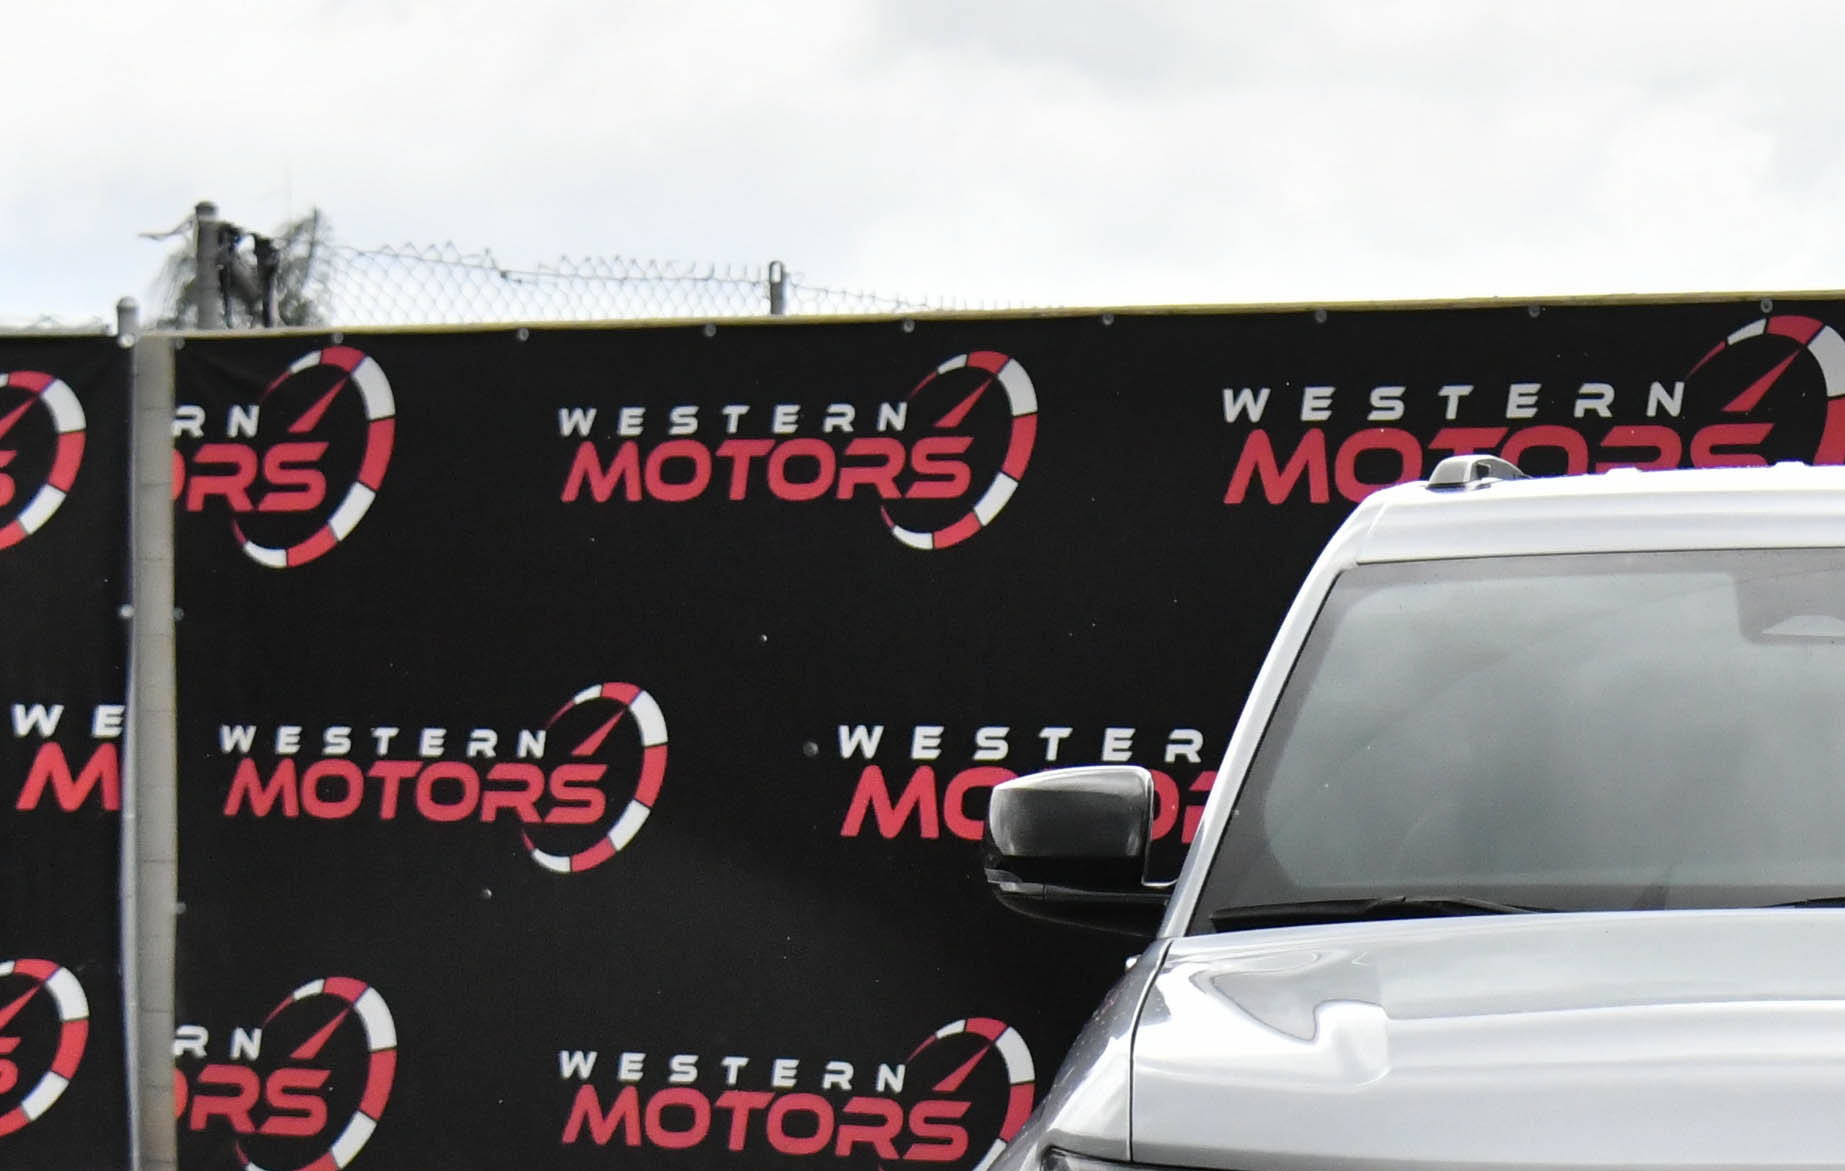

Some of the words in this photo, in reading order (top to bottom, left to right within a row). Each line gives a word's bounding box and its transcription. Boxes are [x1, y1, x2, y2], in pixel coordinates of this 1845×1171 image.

[560, 401, 908, 436] WESTERN
[1222, 380, 1686, 423] WESTERN
[560, 436, 974, 503] MOTORS
[219, 724, 547, 759] WESTERN
[838, 724, 1205, 764] WESTER
[222, 756, 609, 826] MOTORS
[559, 1049, 907, 1094] WESTERN
[560, 1083, 972, 1163] MOTORS
